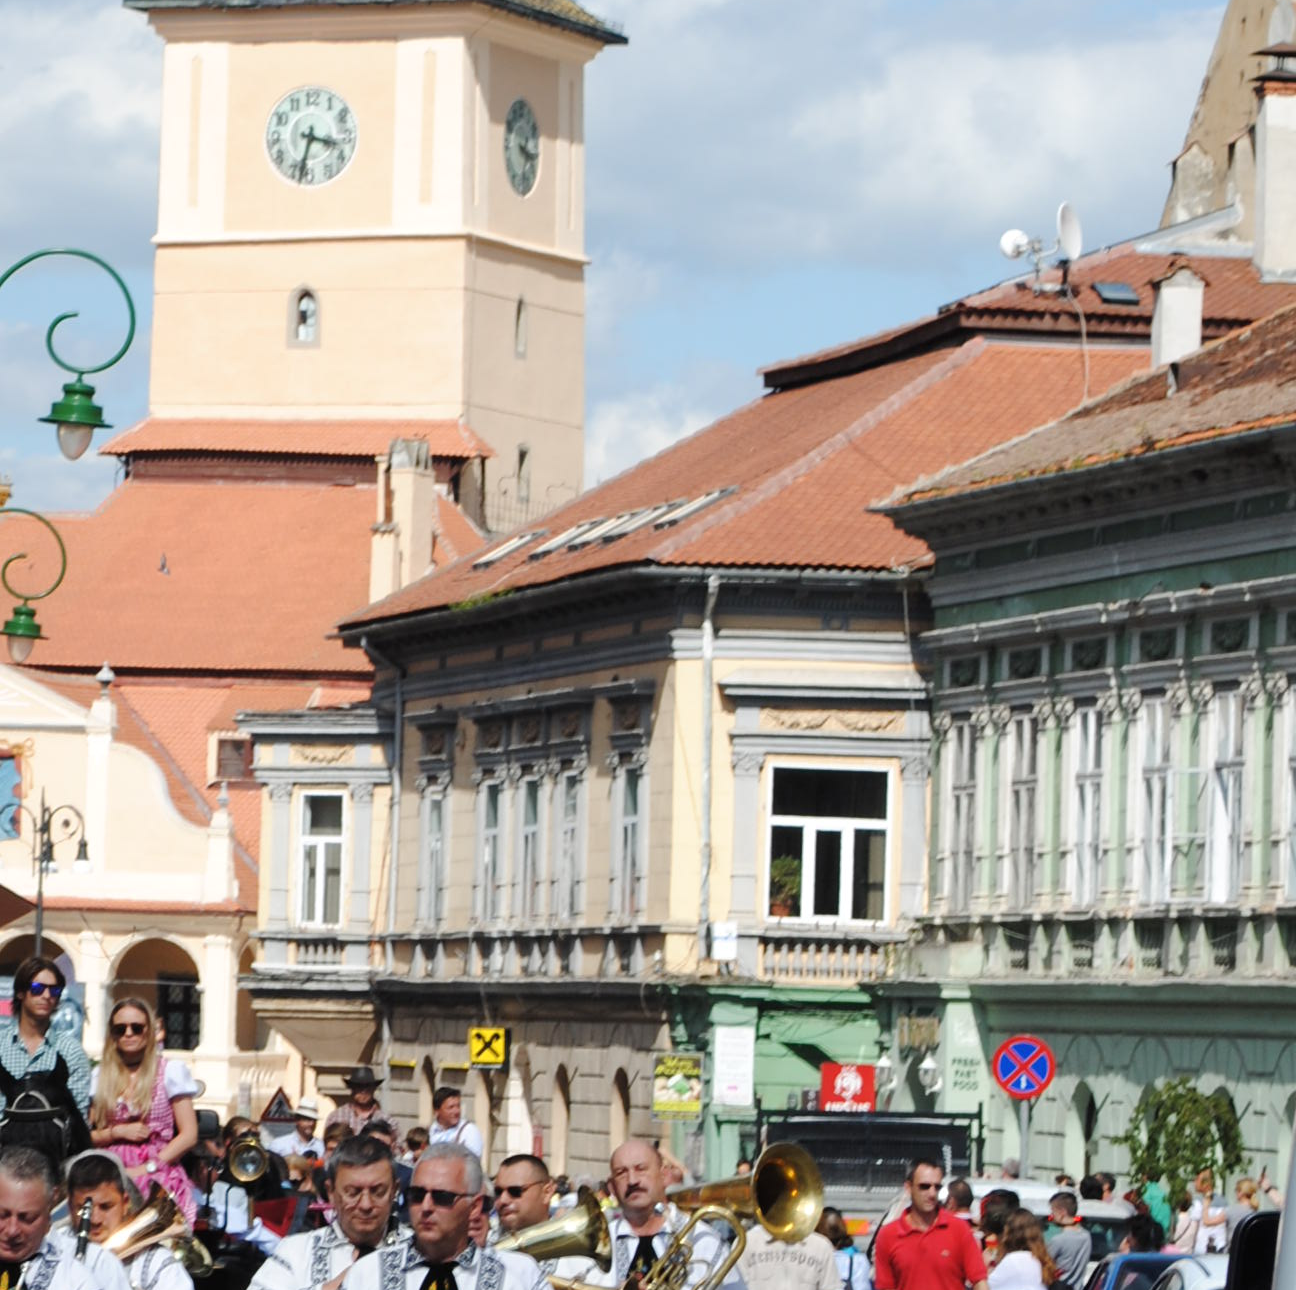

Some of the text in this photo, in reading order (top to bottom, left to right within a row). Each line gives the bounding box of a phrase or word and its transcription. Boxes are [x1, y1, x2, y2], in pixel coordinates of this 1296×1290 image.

[290, 97, 300, 111] 11
[305, 91, 320, 106] 12
[275, 111, 289, 127] 10
[338, 106, 349, 124] 2
[271, 130, 281, 145] 9
[343, 129, 352, 144] 3
[337, 149, 346, 164] 4
[289, 164, 298, 180] 7
[953, 1069, 976, 1078] FAST
